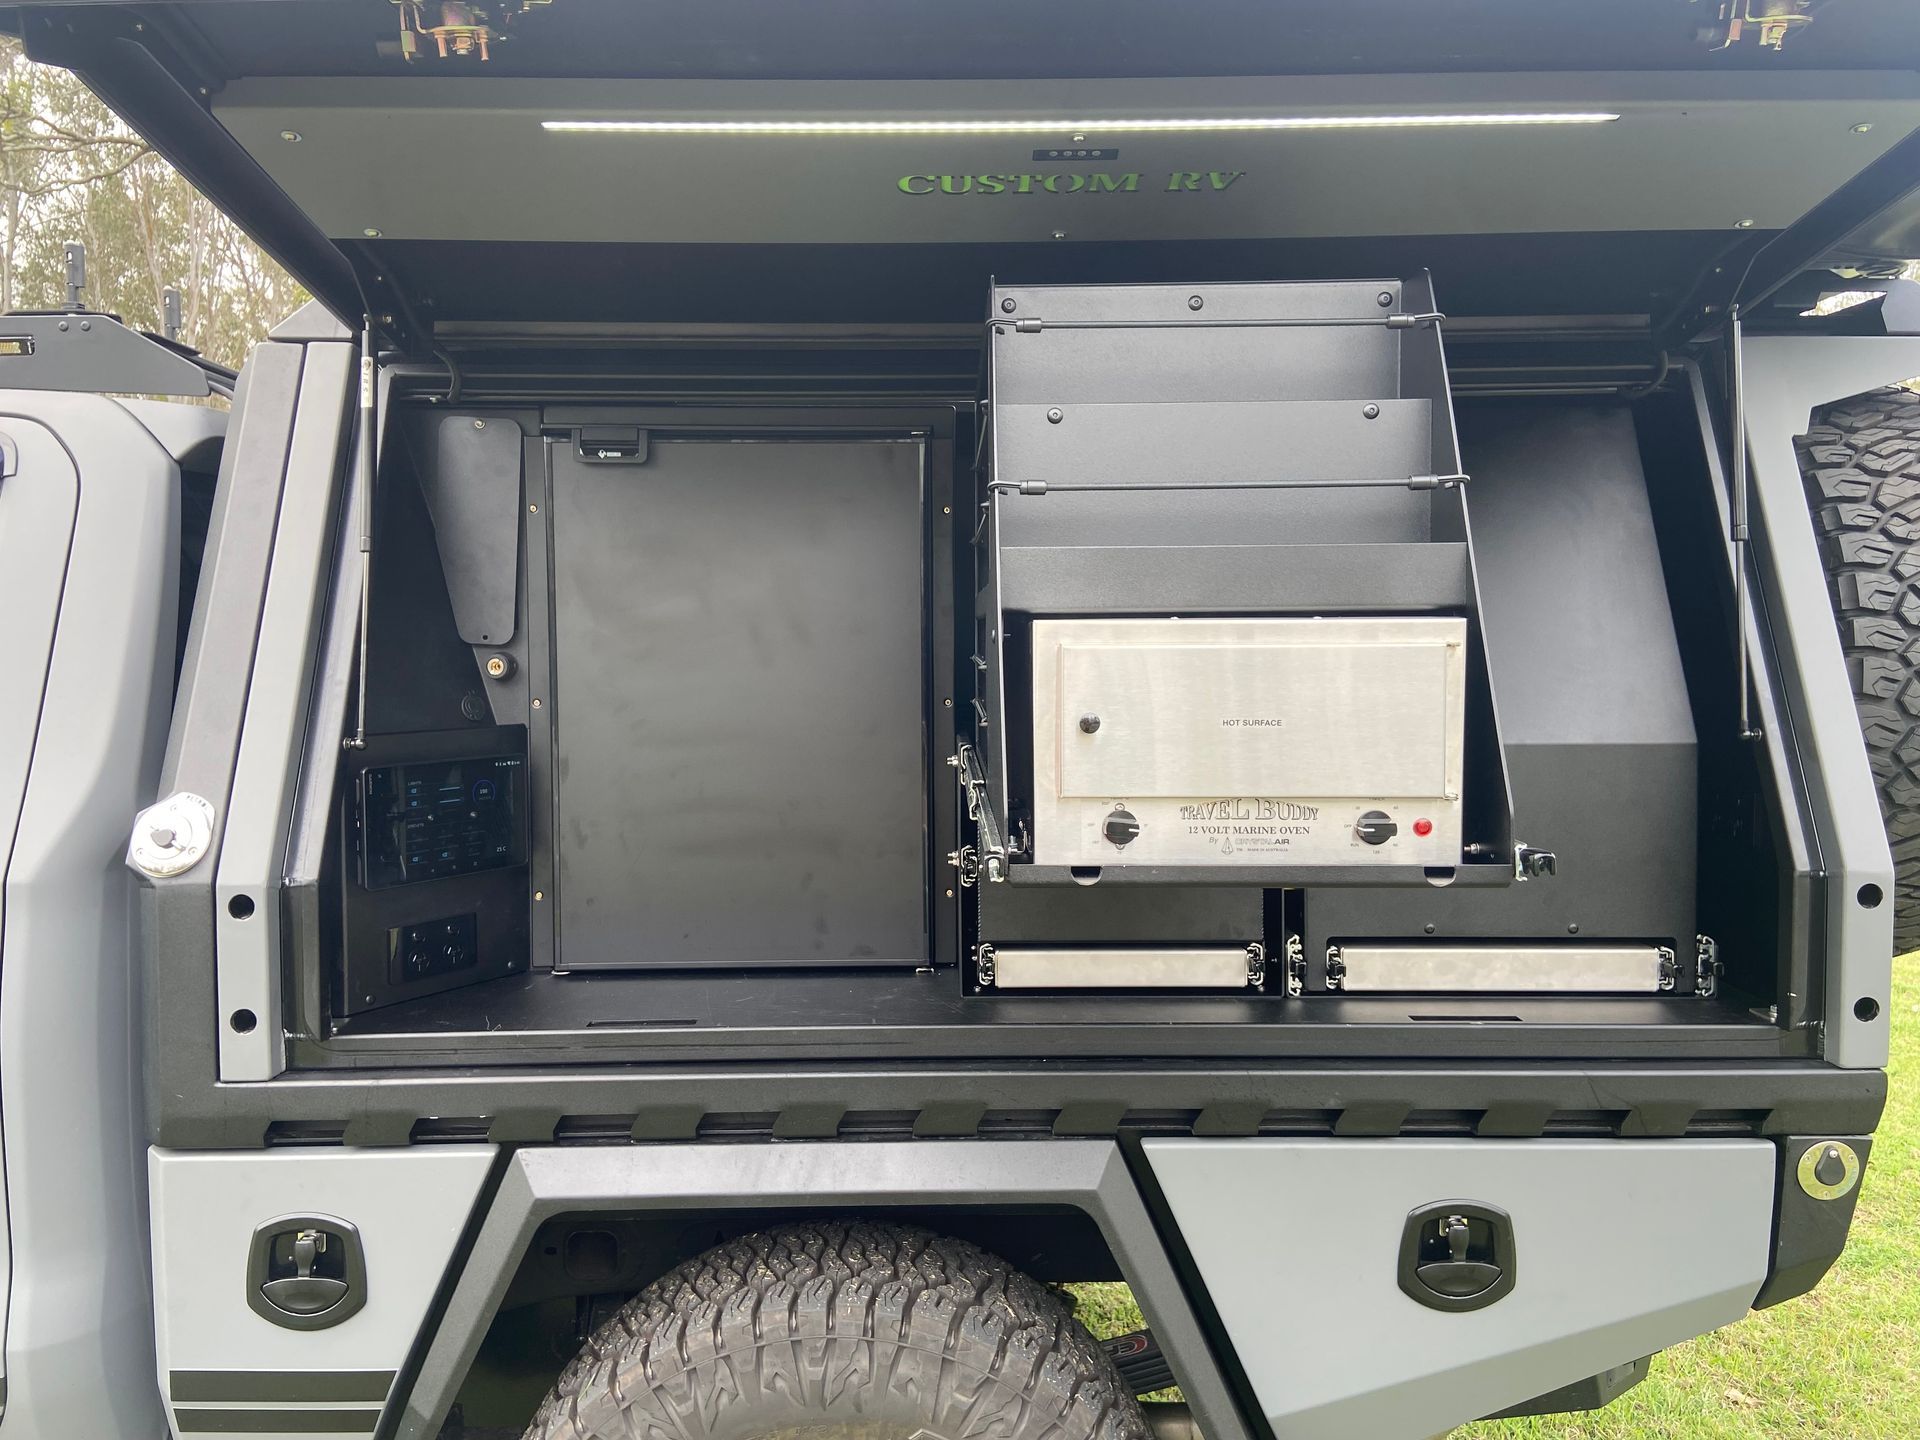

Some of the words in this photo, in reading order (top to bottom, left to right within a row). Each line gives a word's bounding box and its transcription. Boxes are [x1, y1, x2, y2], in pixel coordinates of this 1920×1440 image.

[897, 173, 1145, 195] CUSTOM
[1164, 170, 1247, 193] RV
[1222, 719, 1240, 727] HOT
[1242, 719, 1282, 727] SURFACE
[1179, 797, 1250, 820] TRAVEL
[1255, 797, 1320, 821] BUDDY
[1188, 826, 1198, 834] 12
[1199, 826, 1231, 834] VOLT
[1232, 826, 1277, 834] MARINE
[1279, 826, 1310, 834] OVEN
[1209, 836, 1219, 845] By
